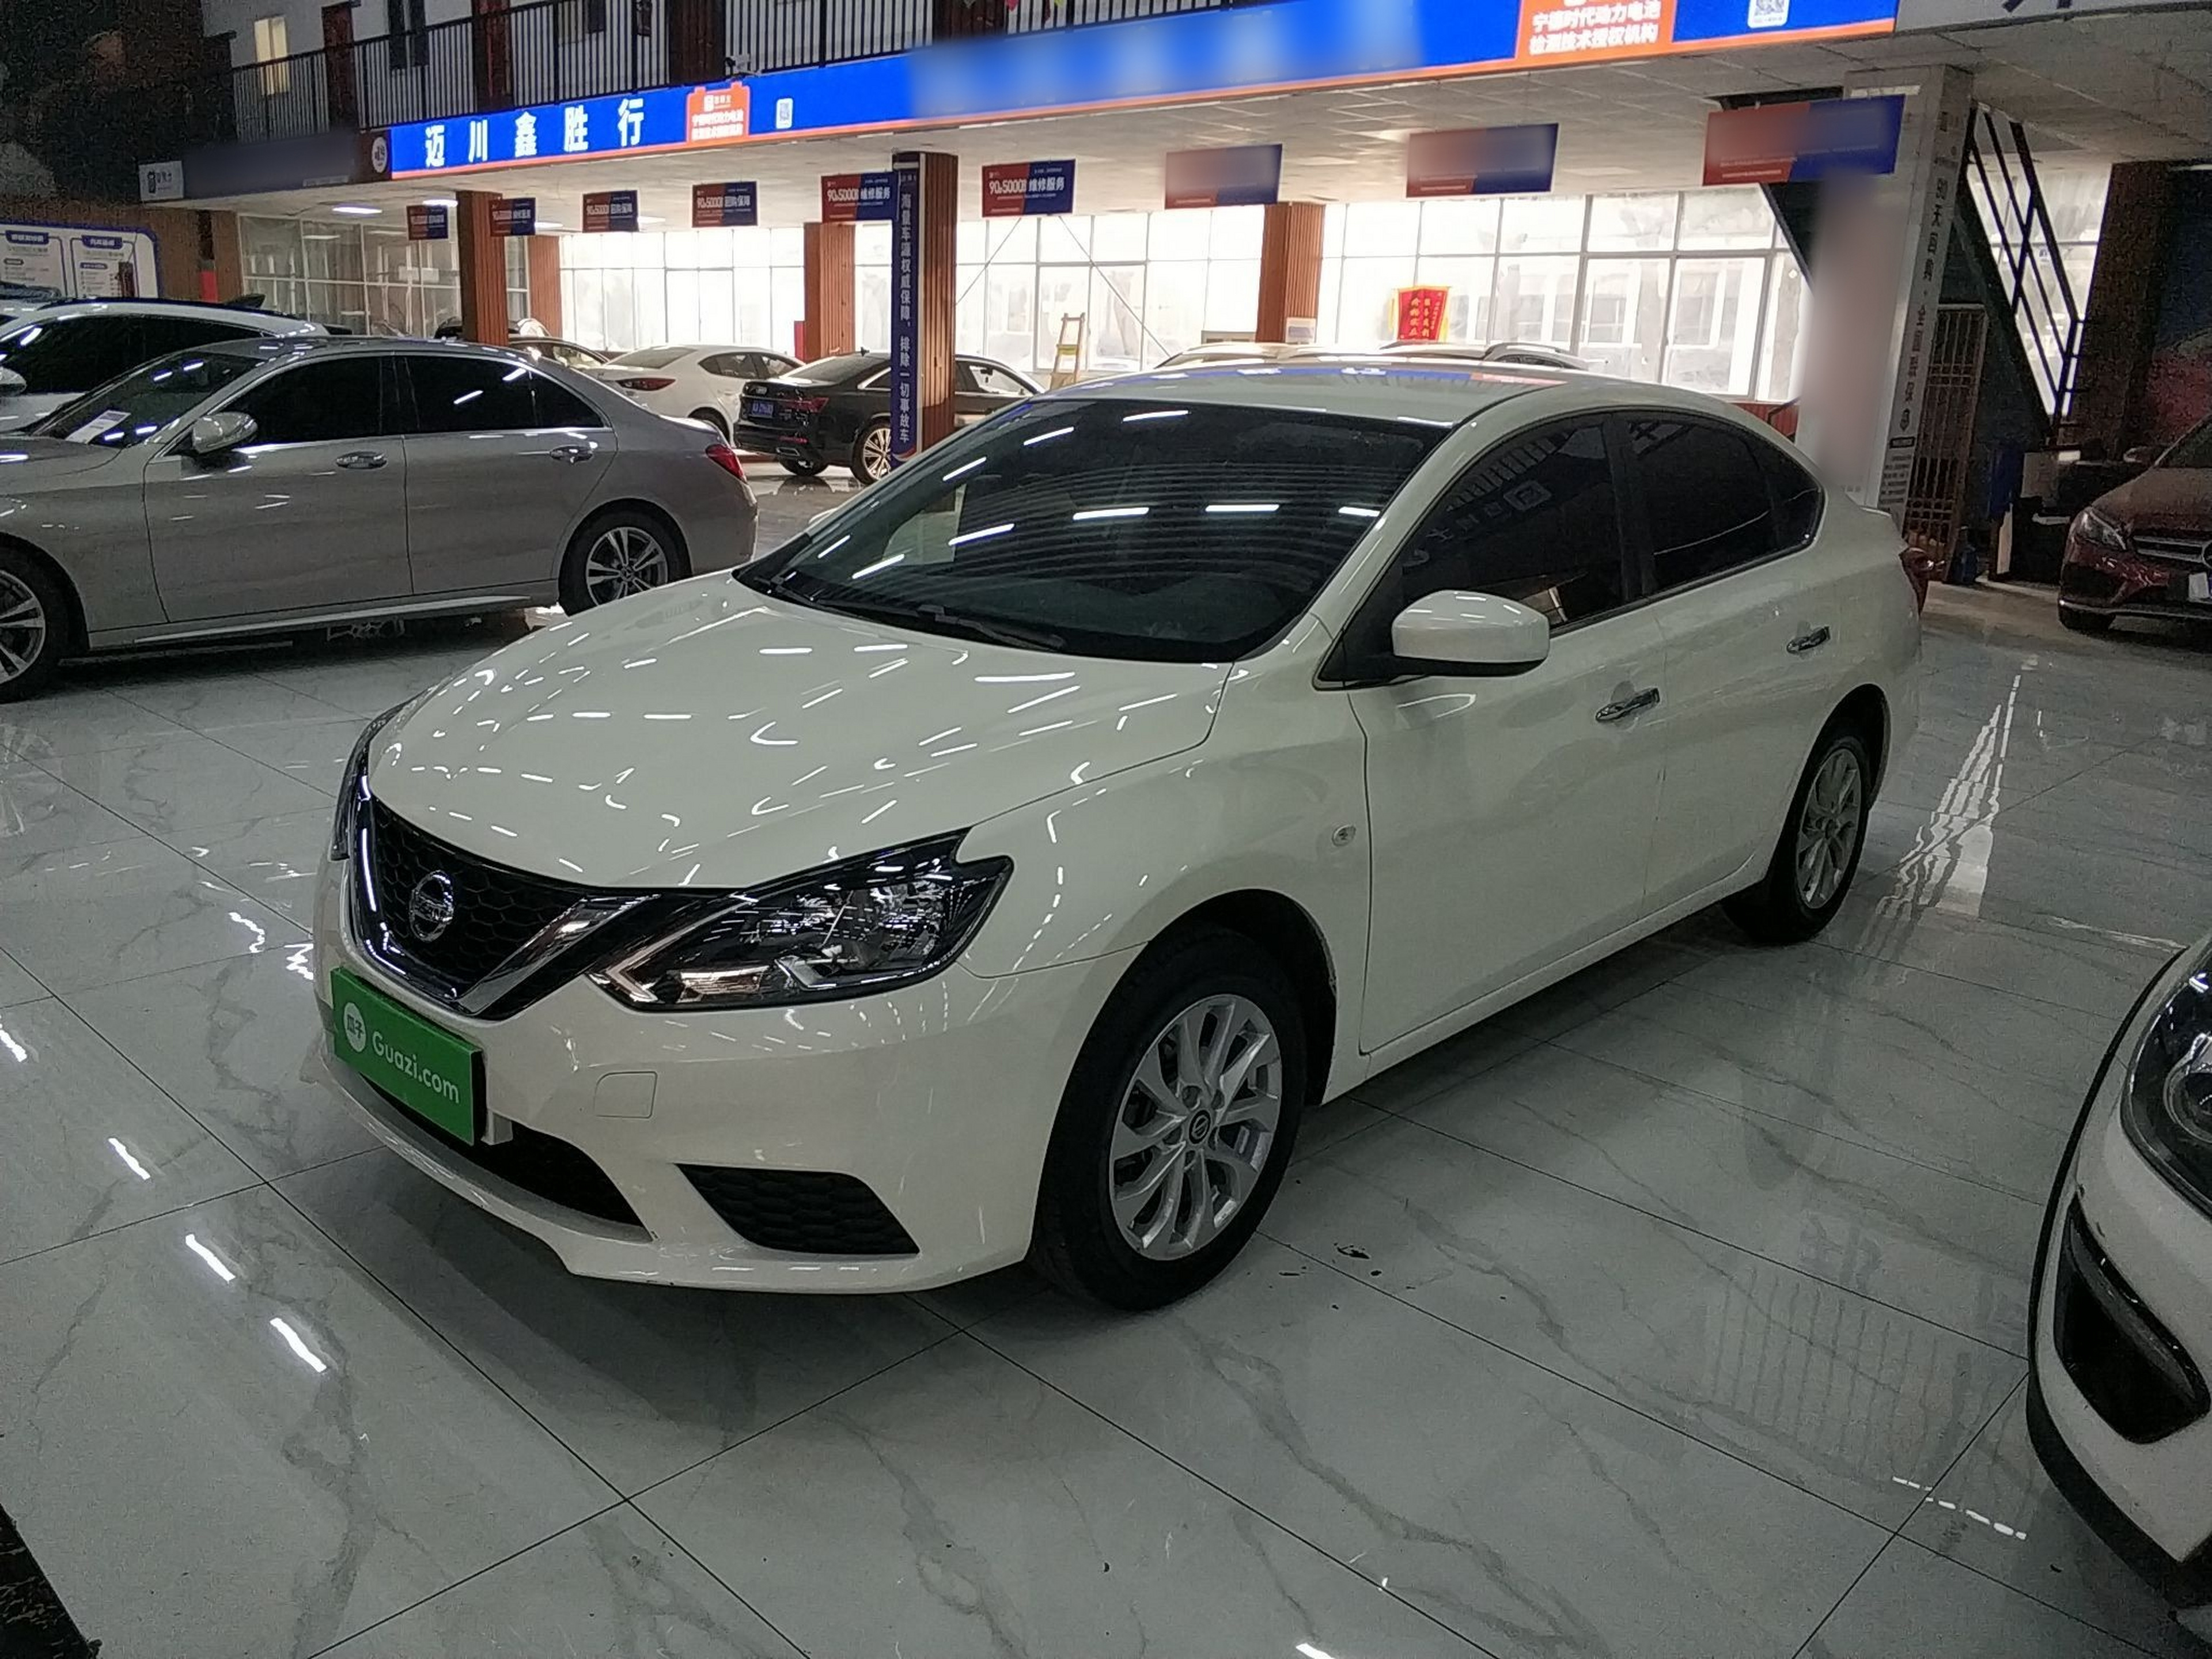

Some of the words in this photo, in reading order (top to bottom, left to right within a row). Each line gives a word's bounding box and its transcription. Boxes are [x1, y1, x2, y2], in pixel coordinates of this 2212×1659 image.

[1532, 1, 1661, 33] 宁德时代动力电池
[1529, 23, 1659, 56] 检测技术授权机构
[372, 1031, 460, 1104] Guazi.com
